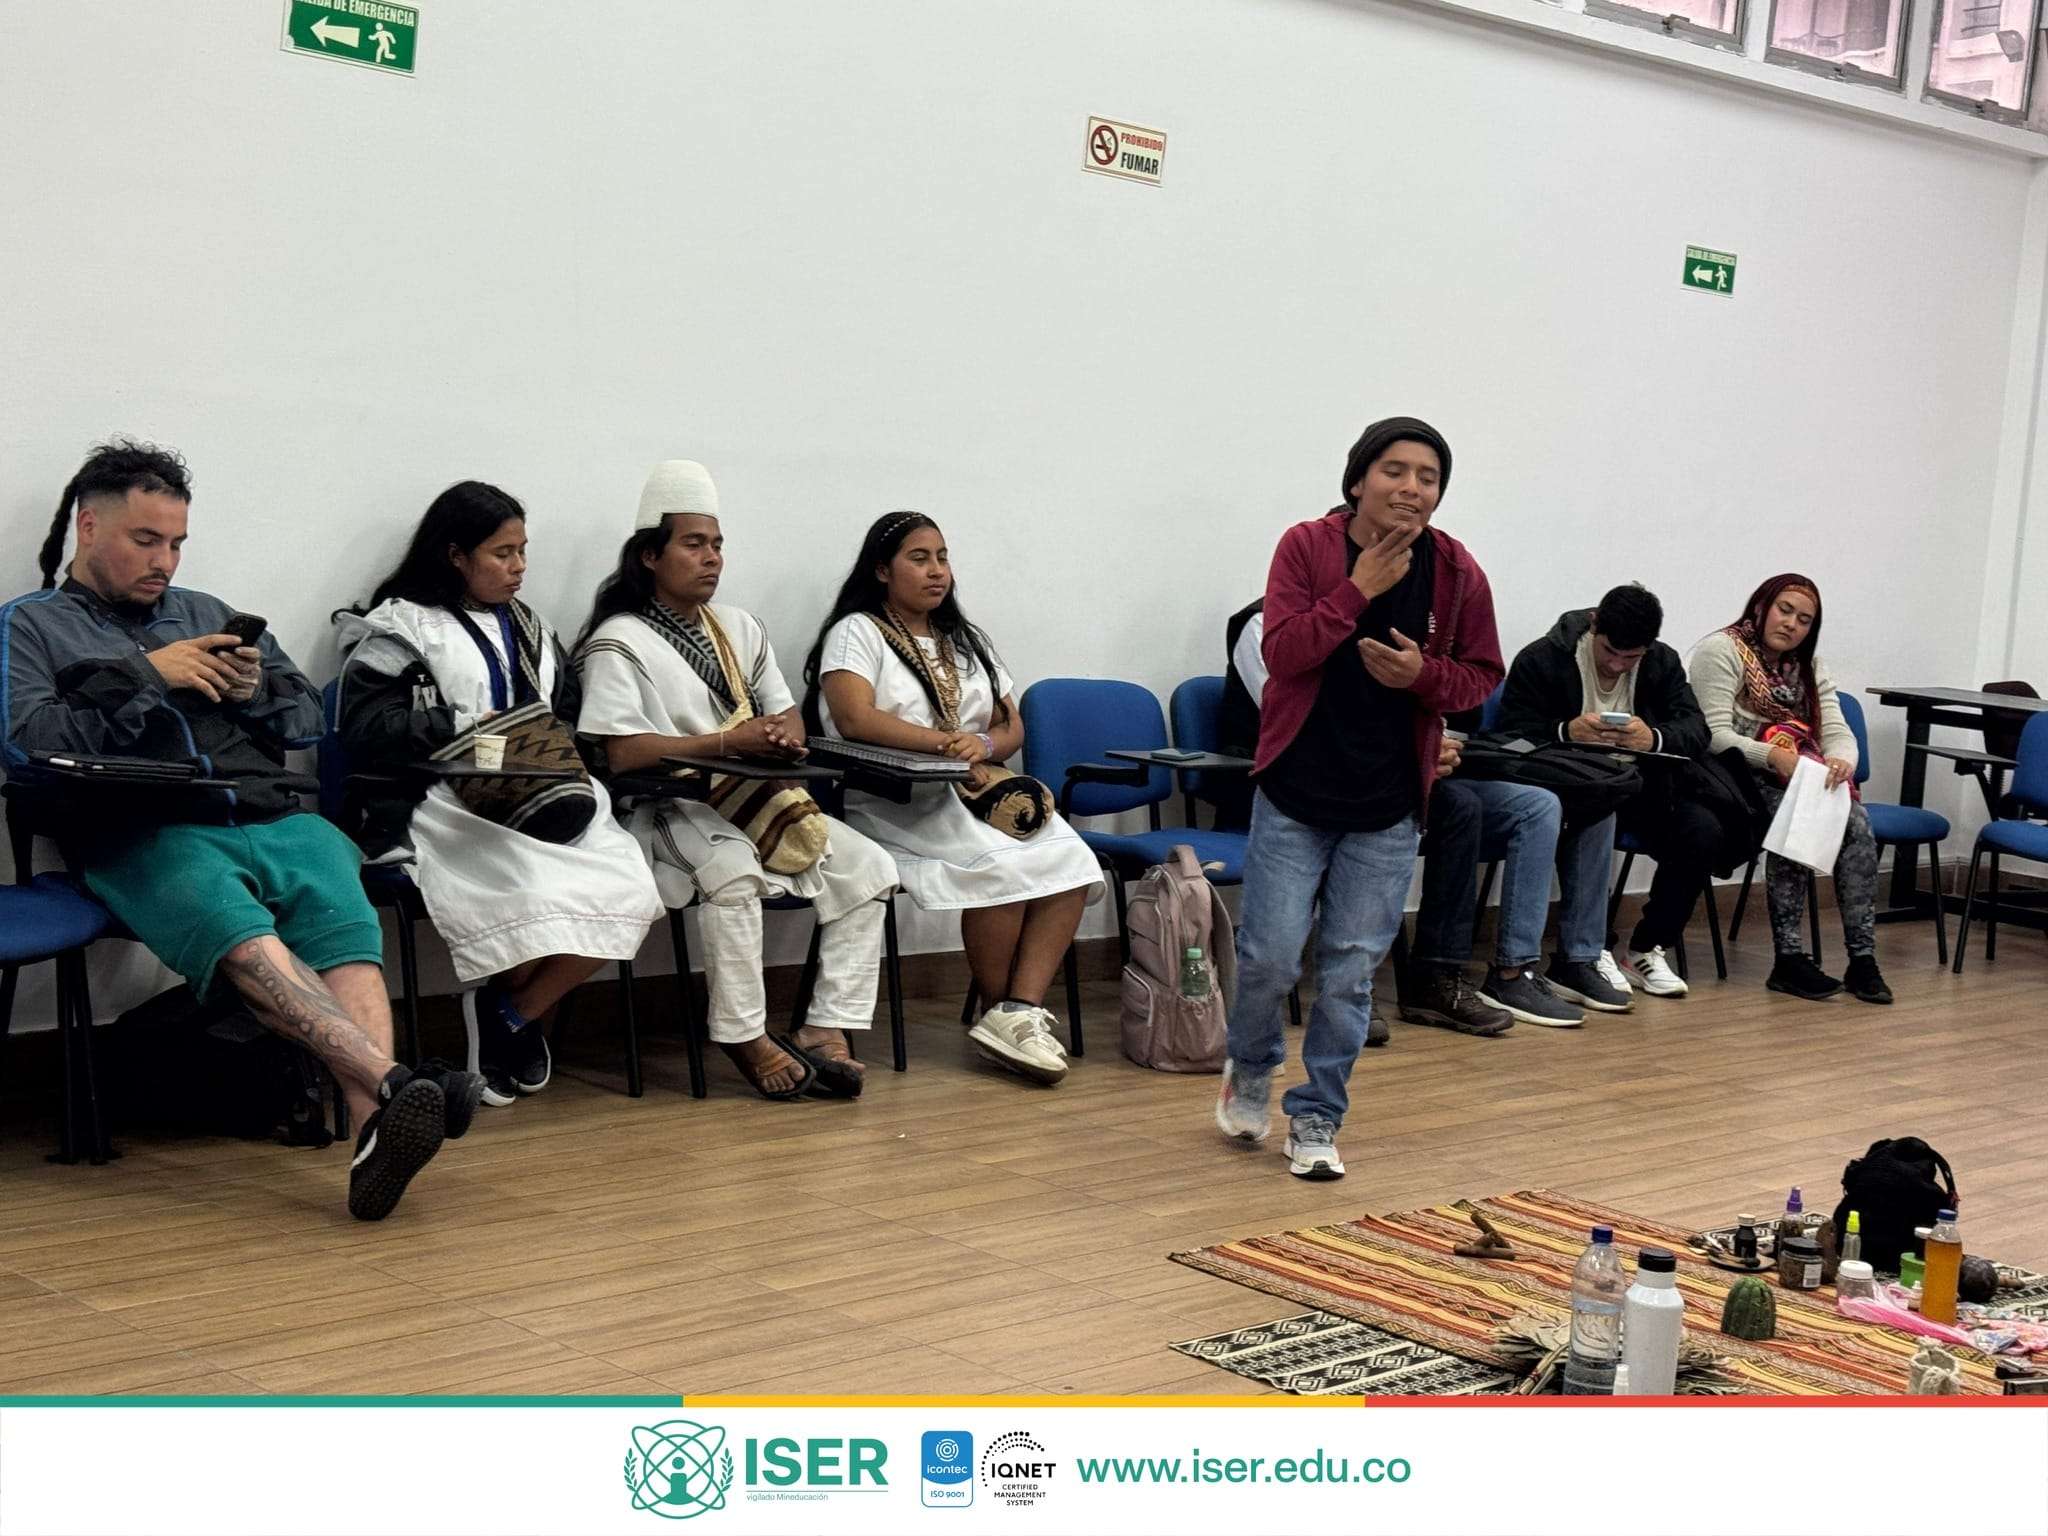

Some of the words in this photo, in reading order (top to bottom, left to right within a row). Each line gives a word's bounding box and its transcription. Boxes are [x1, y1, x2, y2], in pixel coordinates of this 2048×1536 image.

[348, 0, 415, 27] EMERGENCIA
[1120, 132, 1163, 152] PROHIBIDO
[1120, 152, 1159, 176] FUMAR
